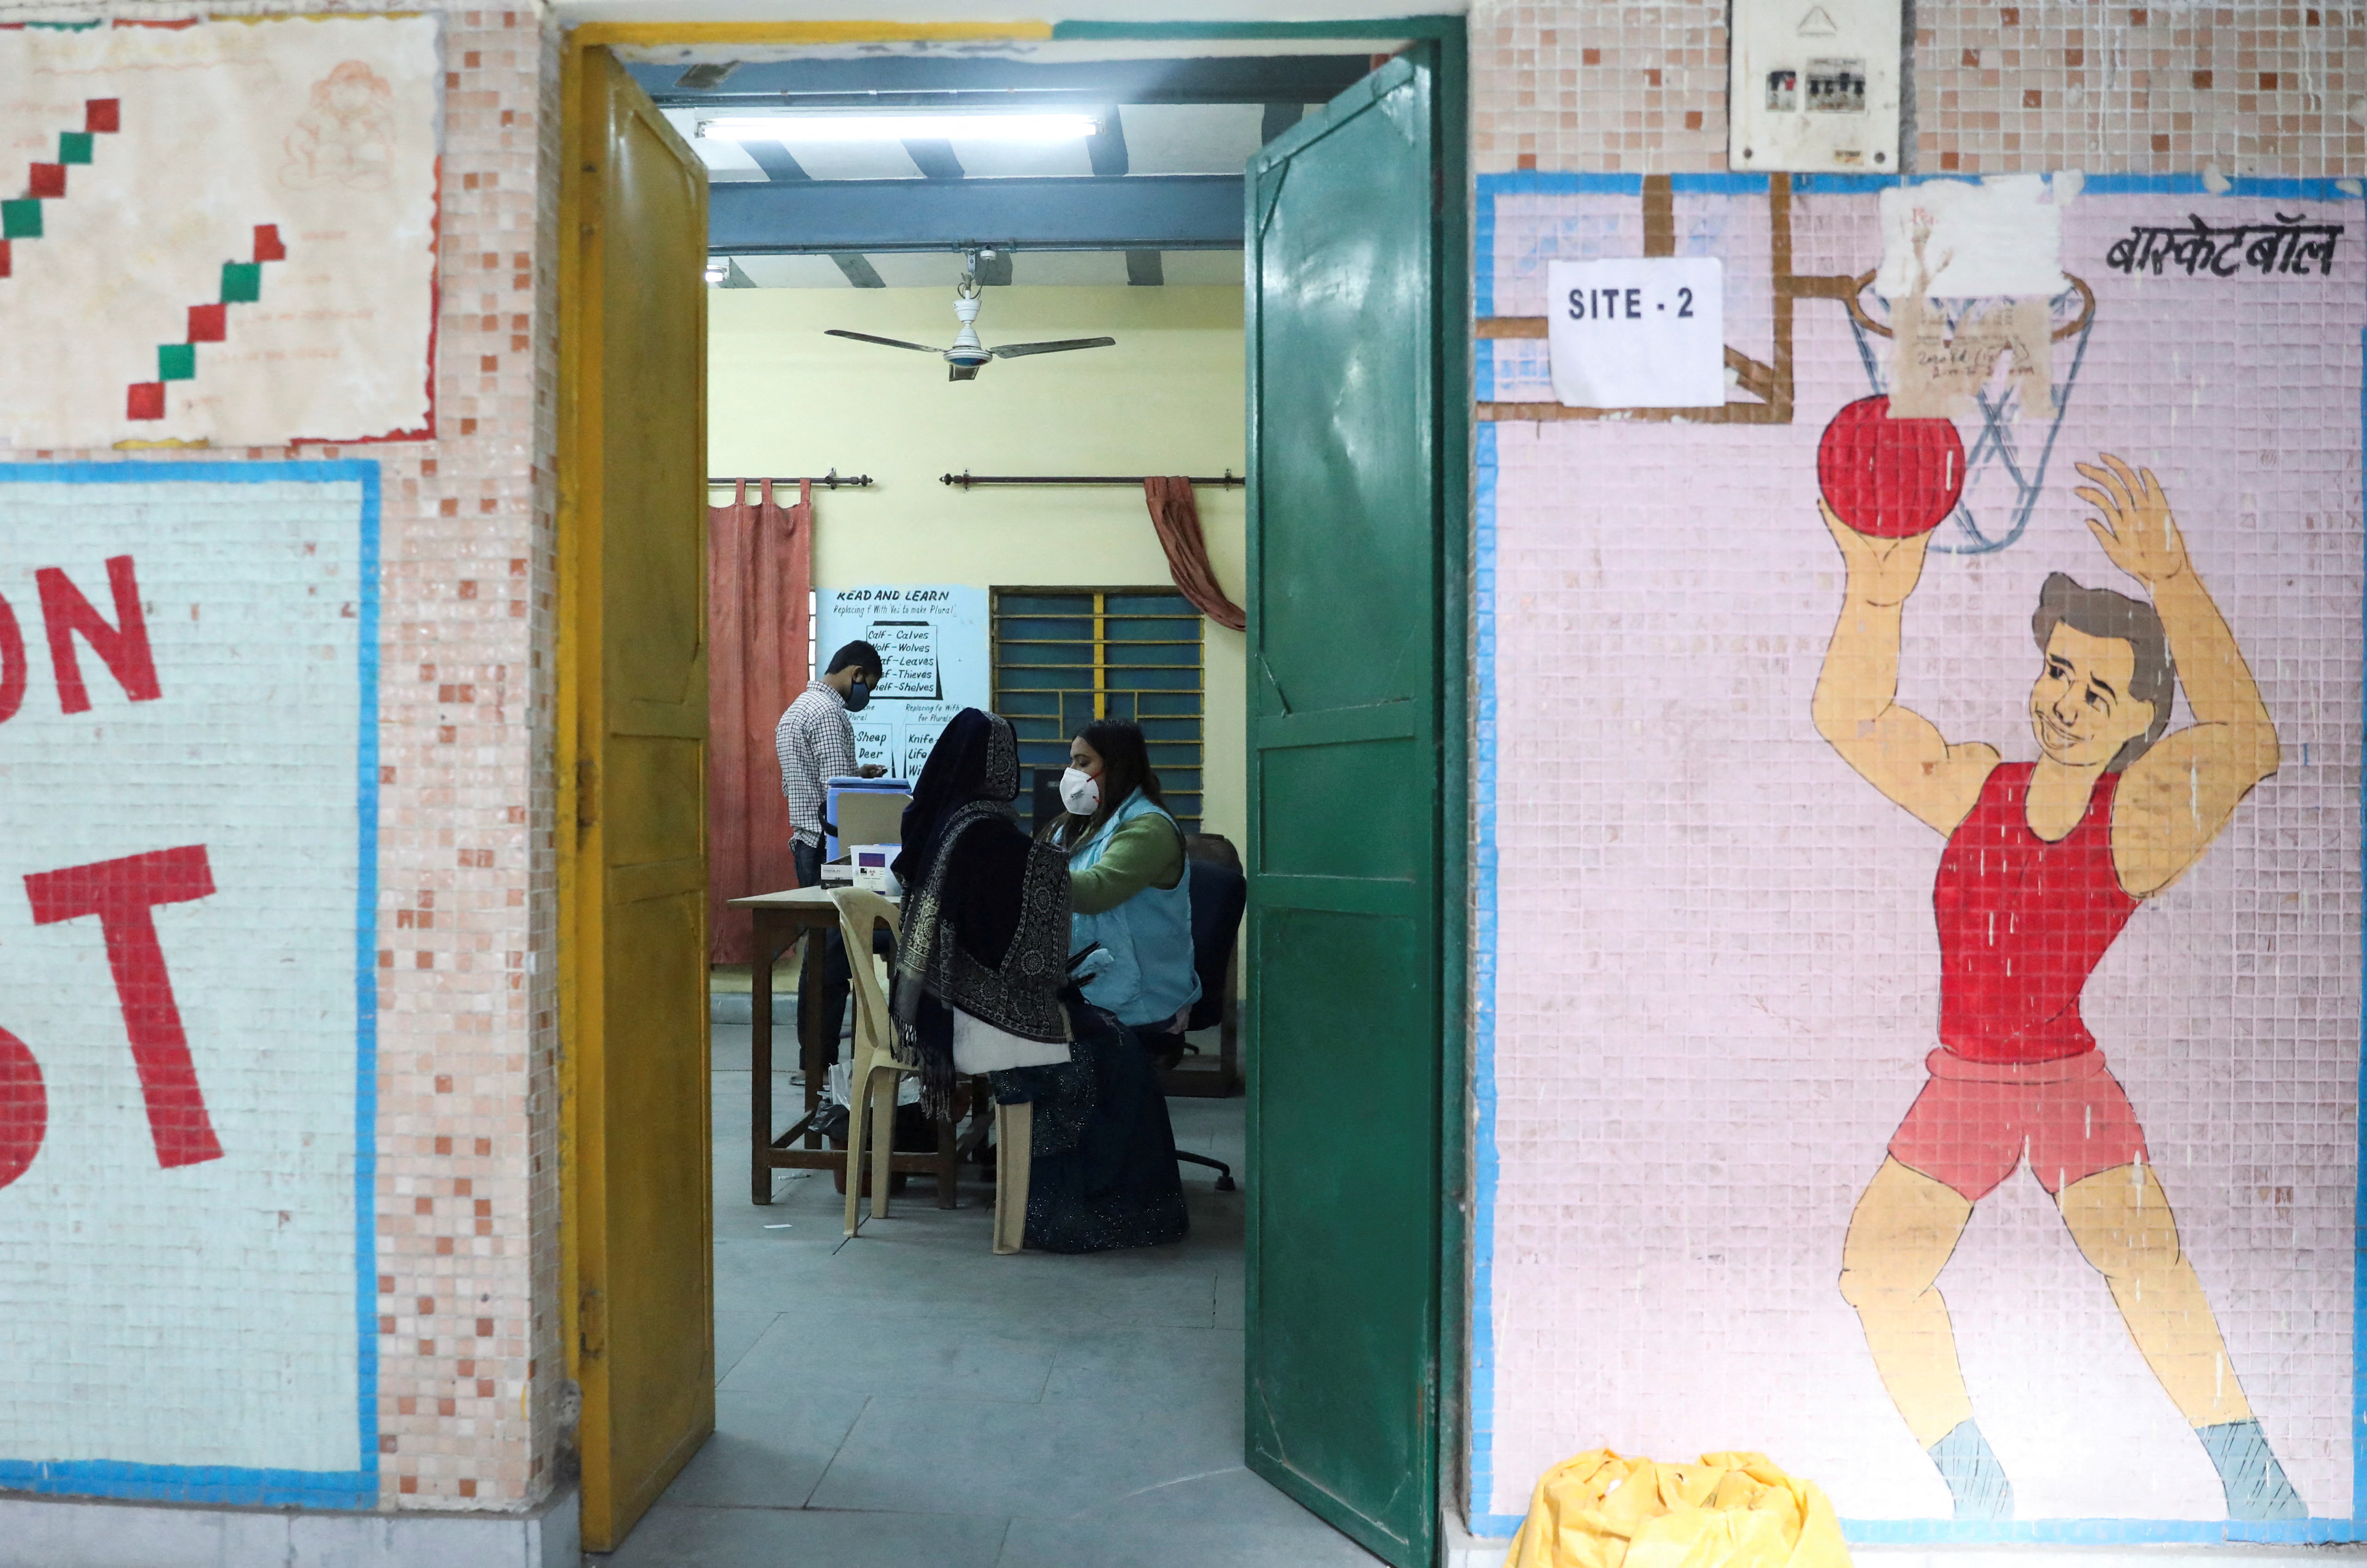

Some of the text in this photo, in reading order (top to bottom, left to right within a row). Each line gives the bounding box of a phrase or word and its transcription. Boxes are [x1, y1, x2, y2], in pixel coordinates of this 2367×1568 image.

[2106, 211, 2344, 277] बास्केटबॉल
[1569, 288, 1641, 320] SITE
[1677, 287, 1693, 318] 2
[874, 590, 900, 601] AND
[905, 591, 949, 601] LEARN
[833, 604, 864, 617] Replacing
[874, 604, 888, 614] With
[902, 604, 909, 614] to
[911, 604, 927, 614] make
[868, 630, 887, 639] Calf
[896, 630, 929, 639] Calves
[0, 554, 162, 725] N
[899, 643, 930, 652] Wolves
[899, 657, 934, 666] Leaves
[899, 670, 932, 678] Thieves
[899, 682, 934, 692] Shelves
[906, 704, 934, 713] Replacing
[848, 712, 868, 721] Plural
[918, 713, 928, 722] for
[908, 734, 934, 743] Knife
[859, 748, 883, 759] Deer
[908, 748, 927, 759] Life
